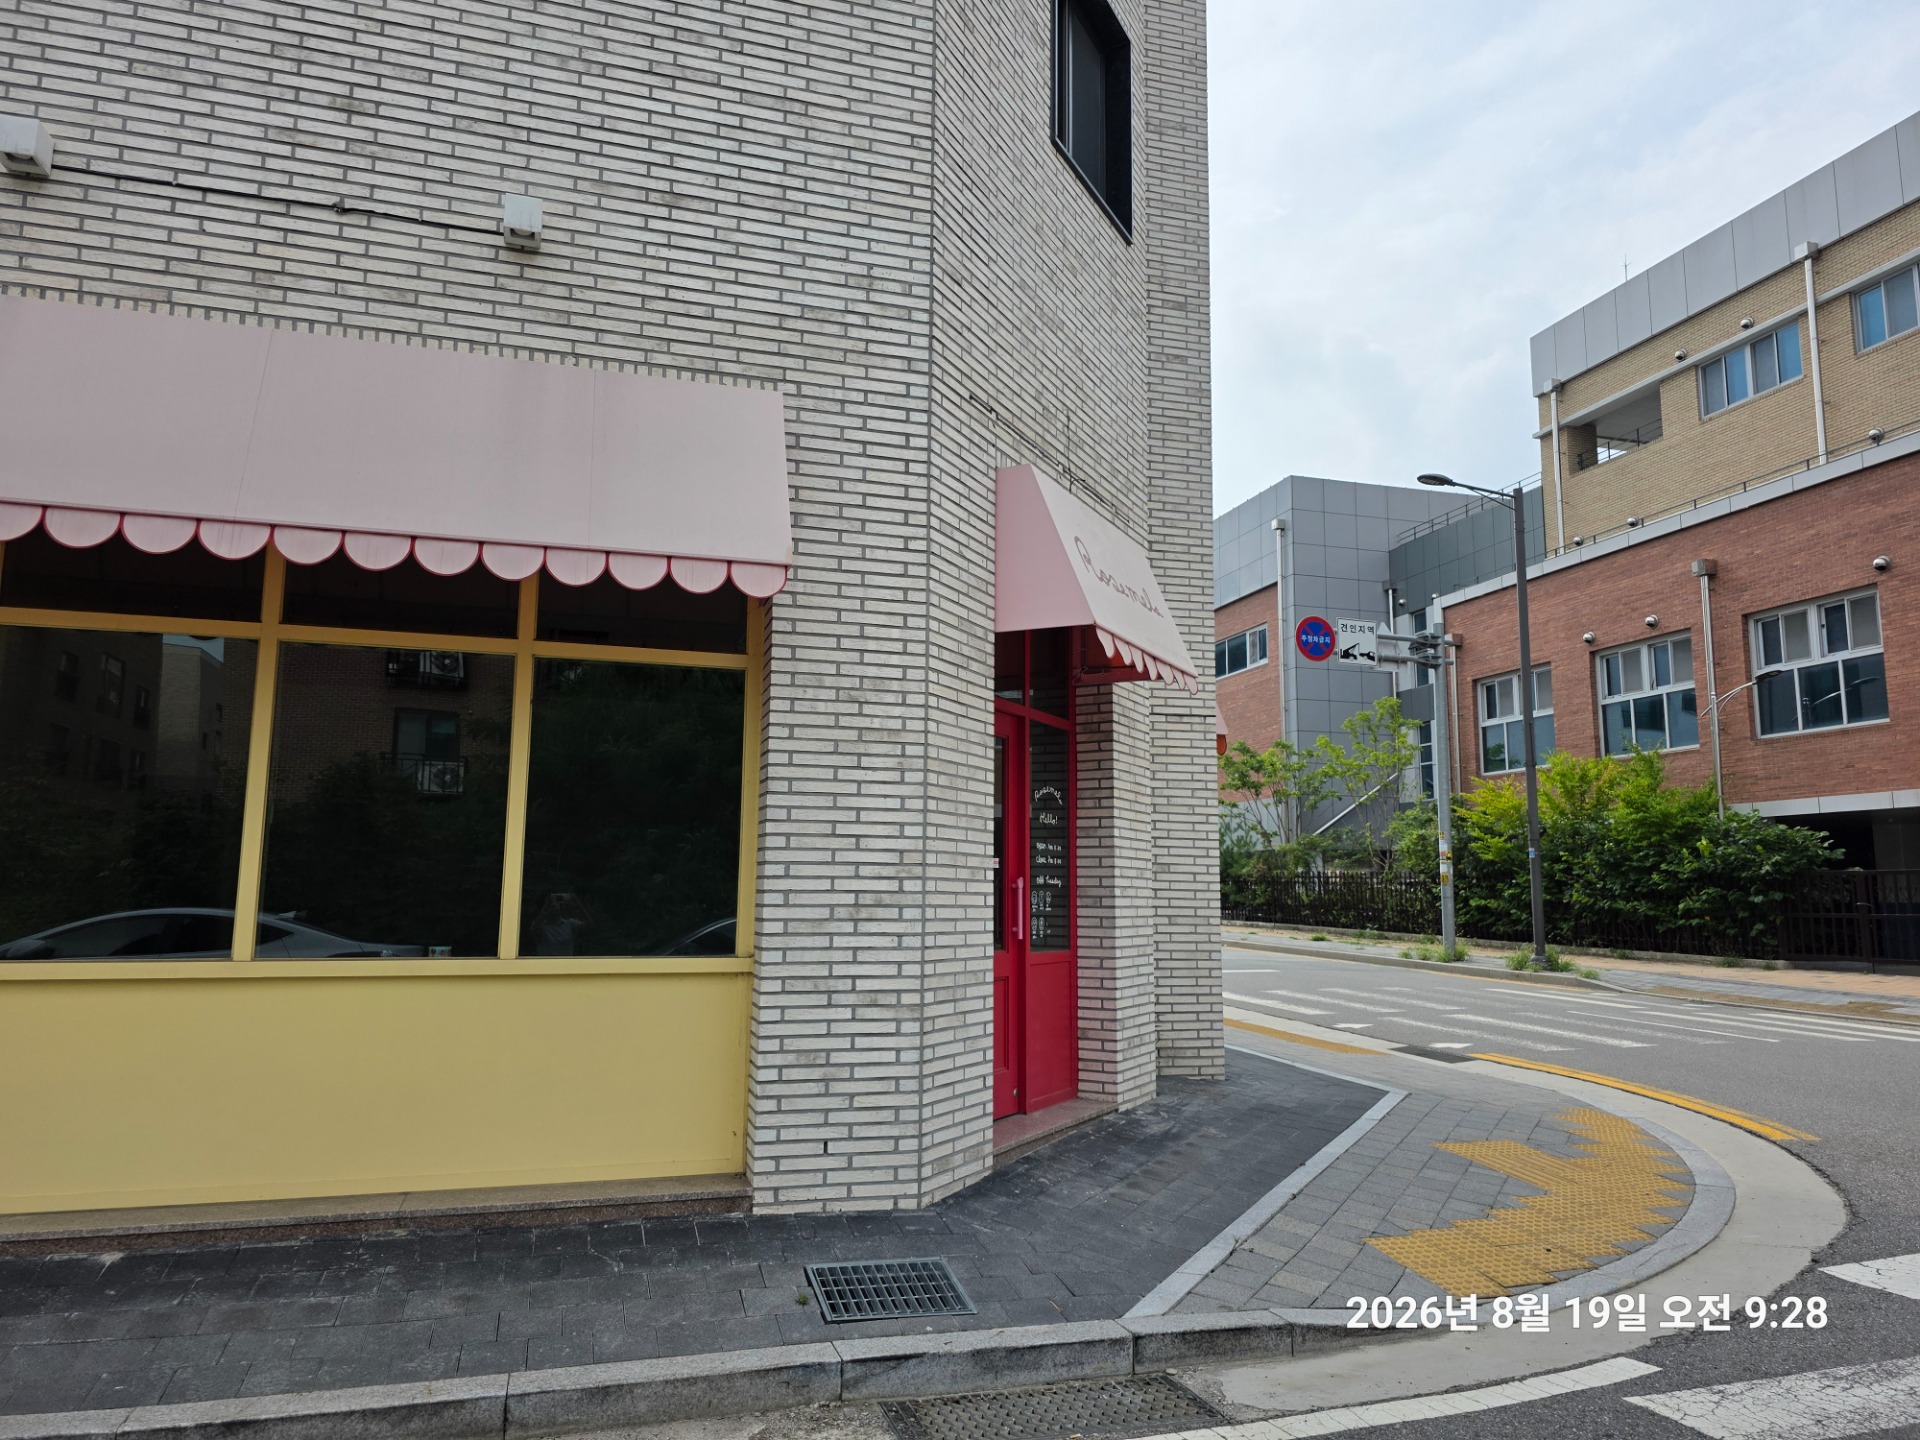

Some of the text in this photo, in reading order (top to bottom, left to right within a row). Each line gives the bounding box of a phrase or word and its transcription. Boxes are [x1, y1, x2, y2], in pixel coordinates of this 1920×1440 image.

[1340, 623, 1375, 635] 견인지역
[1301, 634, 1331, 644] 주정차금지
[1039, 812, 1058, 826] Hello!
